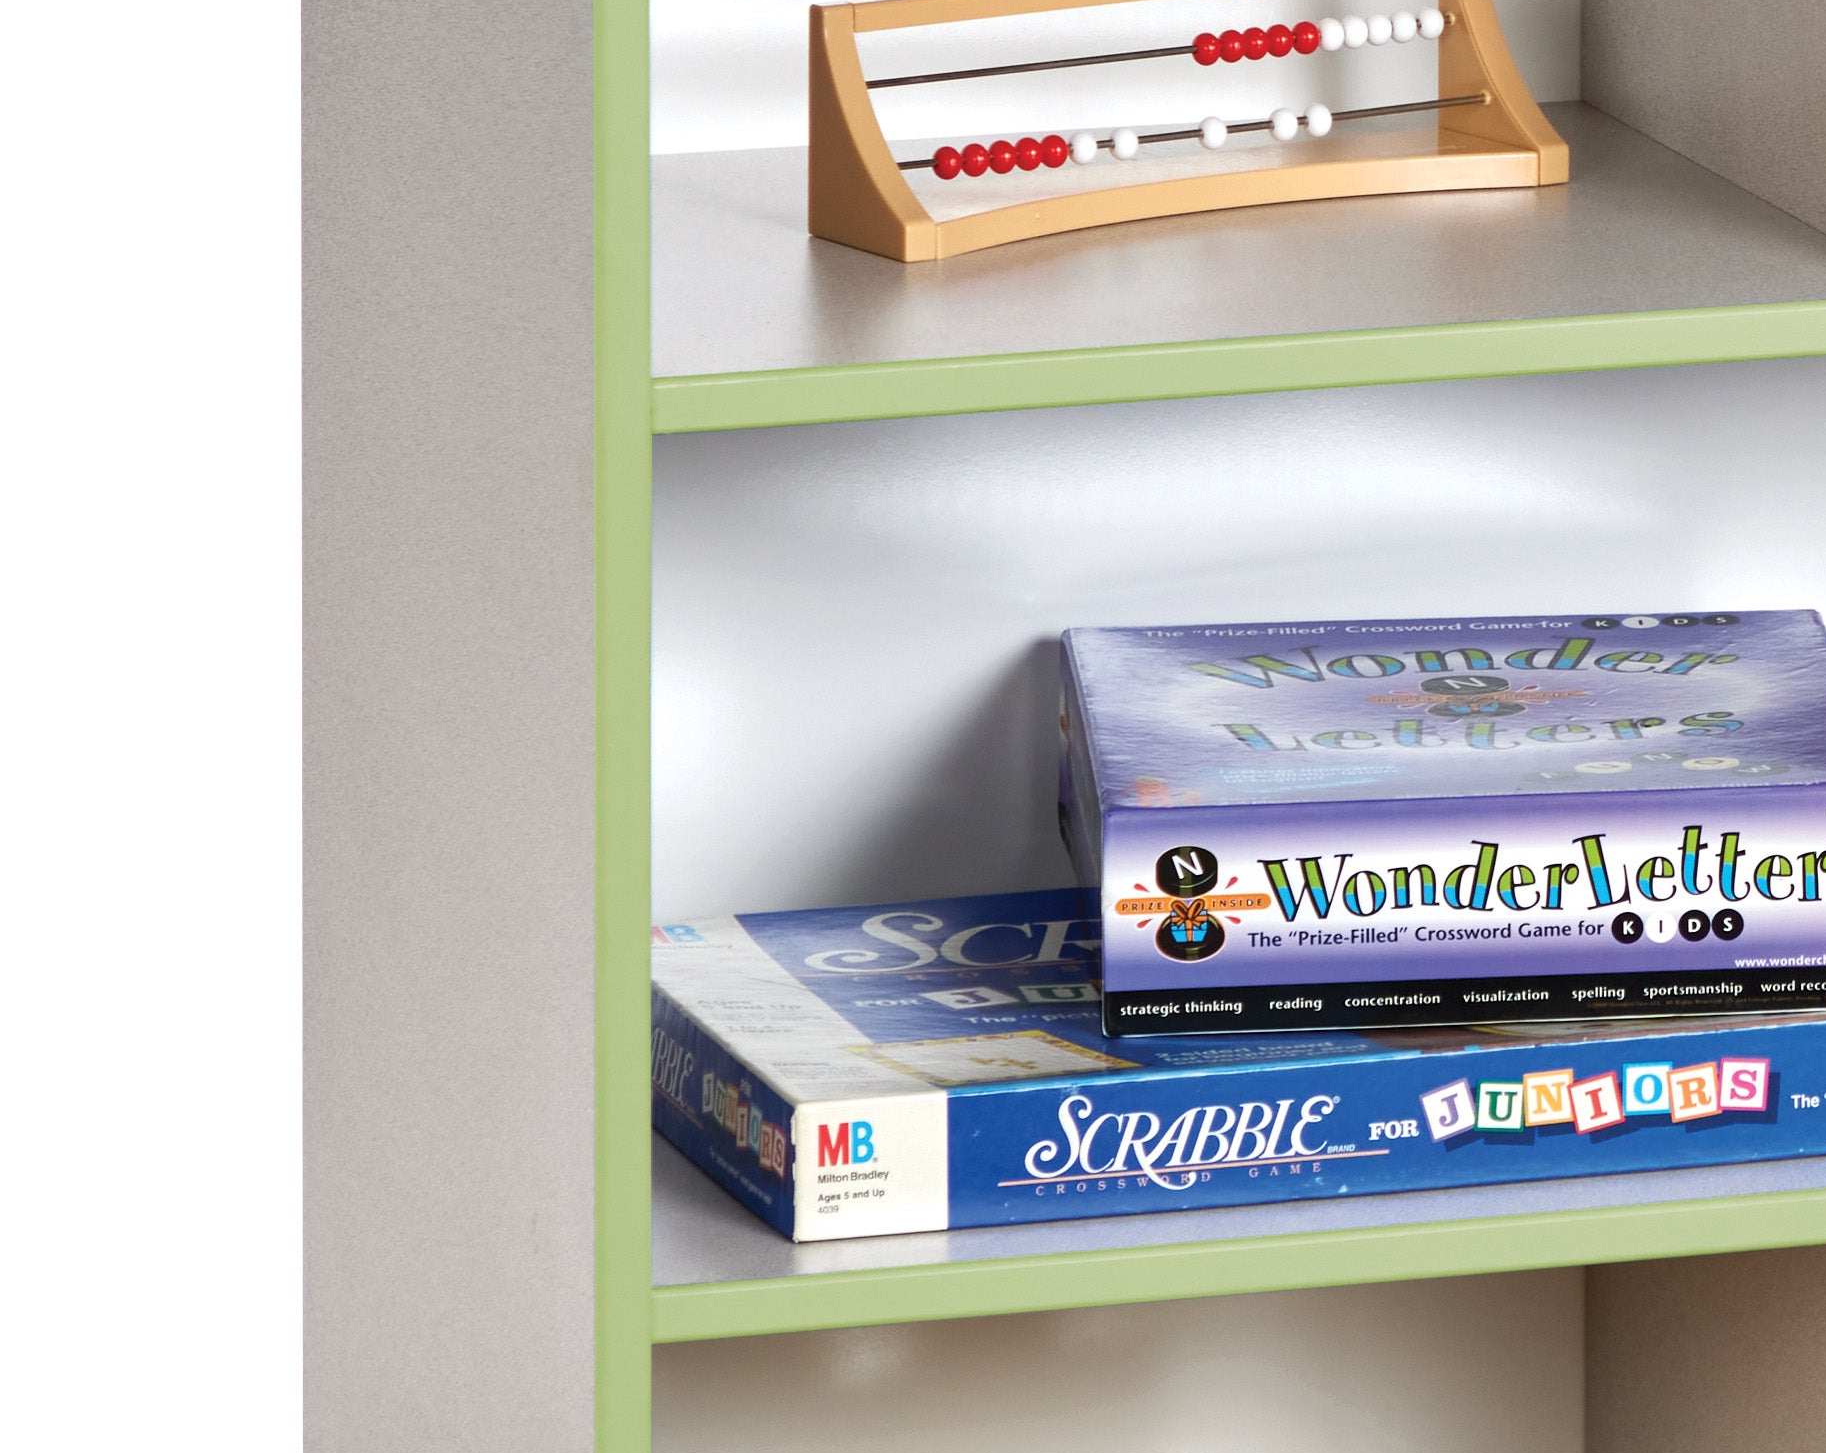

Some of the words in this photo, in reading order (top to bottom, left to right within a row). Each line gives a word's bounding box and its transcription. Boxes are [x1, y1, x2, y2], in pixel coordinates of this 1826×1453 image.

[1145, 630, 1184, 638] The
[1344, 622, 1463, 635] Crossword
[1467, 620, 1535, 631] Game
[1538, 619, 1574, 629] for
[1189, 635, 1741, 690] Wonder
[1211, 706, 1745, 752] Letters
[1170, 851, 1204, 880] N
[1121, 901, 1163, 911] PRIZE
[1212, 897, 1264, 909] INSIDE
[1248, 932, 1282, 948] The
[1414, 923, 1512, 943] Crossword
[1518, 922, 1572, 938] Game
[1578, 920, 1604, 936] for
[1571, 986, 1625, 1002] spelling
[1643, 982, 1743, 997] sportsmanship
[1761, 979, 1796, 993] word
[1269, 995, 1323, 1012] reading
[1345, 992, 1441, 1008] concentration
[1462, 987, 1550, 1004] visualization
[1120, 1001, 1181, 1018] strategic
[1184, 999, 1243, 1015] thinking
[1369, 1120, 1419, 1140] FOR
[1438, 1068, 1760, 1127] JUNIORS
[1791, 1094, 1820, 1109] The
[817, 1121, 875, 1168] MB
[1025, 1095, 1335, 1190] SCRABBLE
[1327, 1144, 1356, 1154] BRAND
[817, 1173, 849, 1185] Milton
[851, 1169, 889, 1182] Bradley
[1035, 1171, 1210, 1196] CROSSWORD
[1249, 1162, 1322, 1178] GAME
[817, 1193, 842, 1204] Ages
[852, 1190, 870, 1199] and
[872, 1188, 885, 1199] Up
[817, 1204, 839, 1214] 4039
